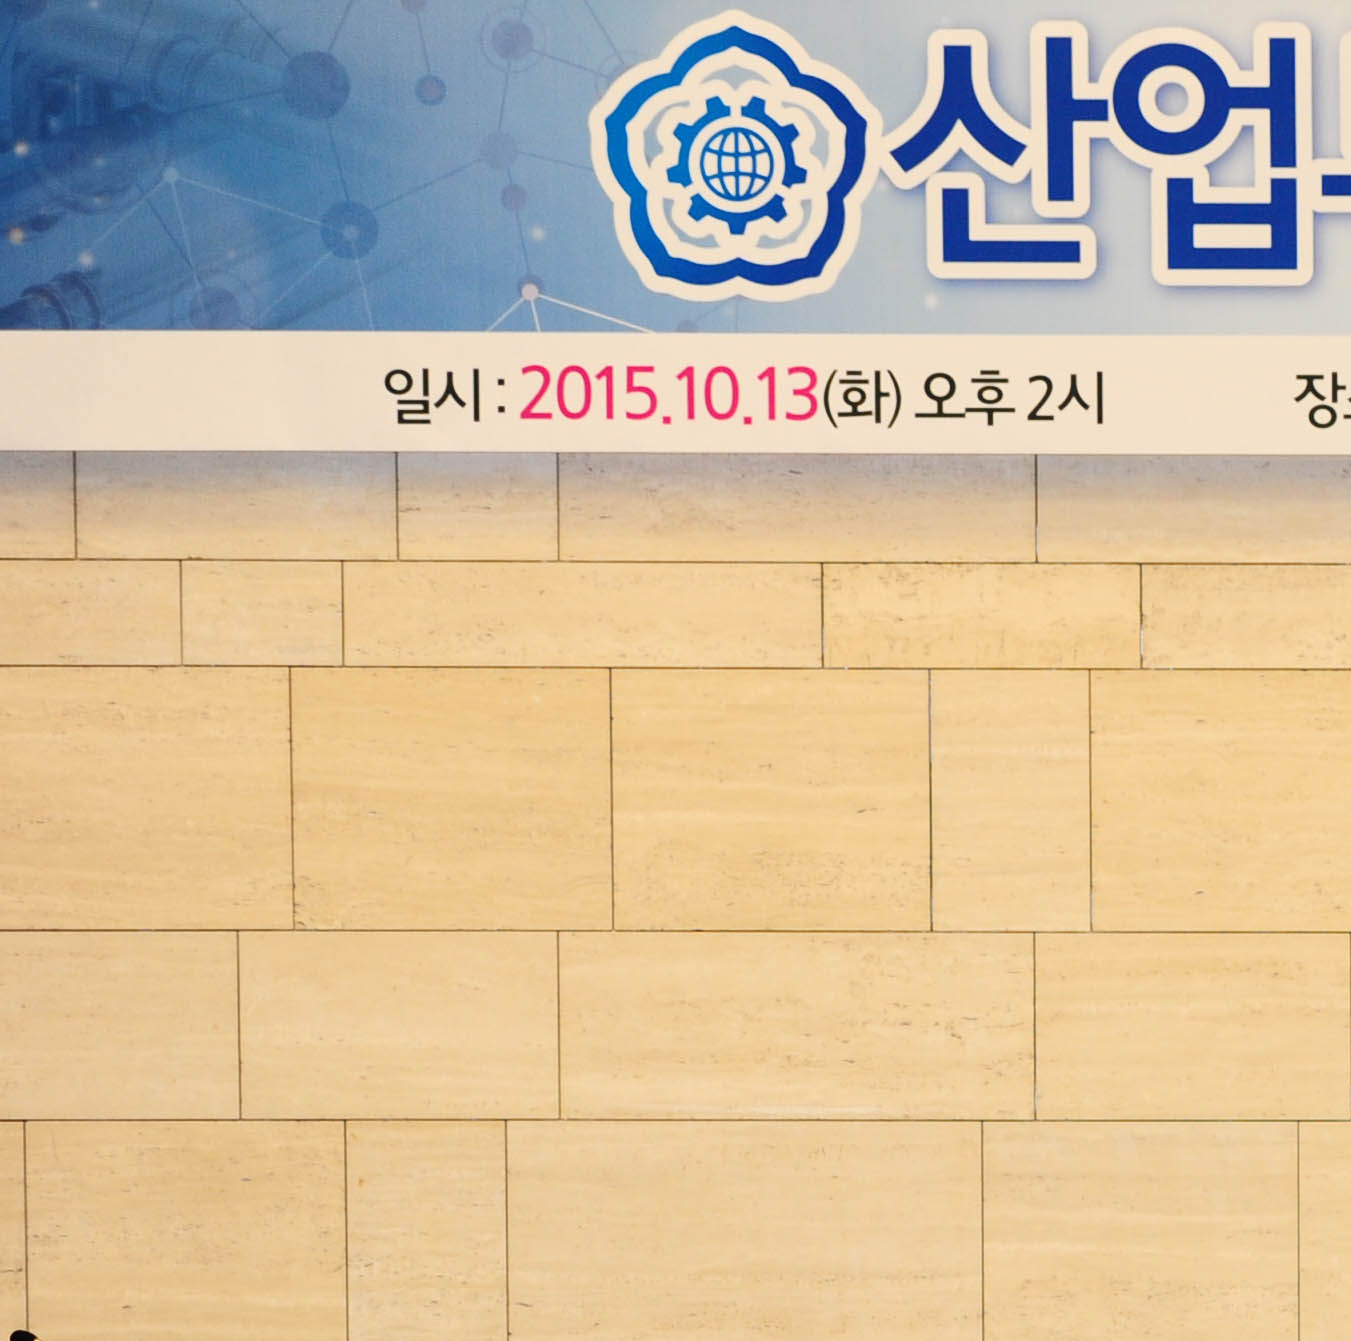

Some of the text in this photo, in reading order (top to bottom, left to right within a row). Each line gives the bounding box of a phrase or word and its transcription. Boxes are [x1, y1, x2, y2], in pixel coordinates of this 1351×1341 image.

[519, 363, 903, 430] 2015.10.13(화)
[913, 368, 1017, 428] 오후
[1026, 370, 1105, 426] 2시
